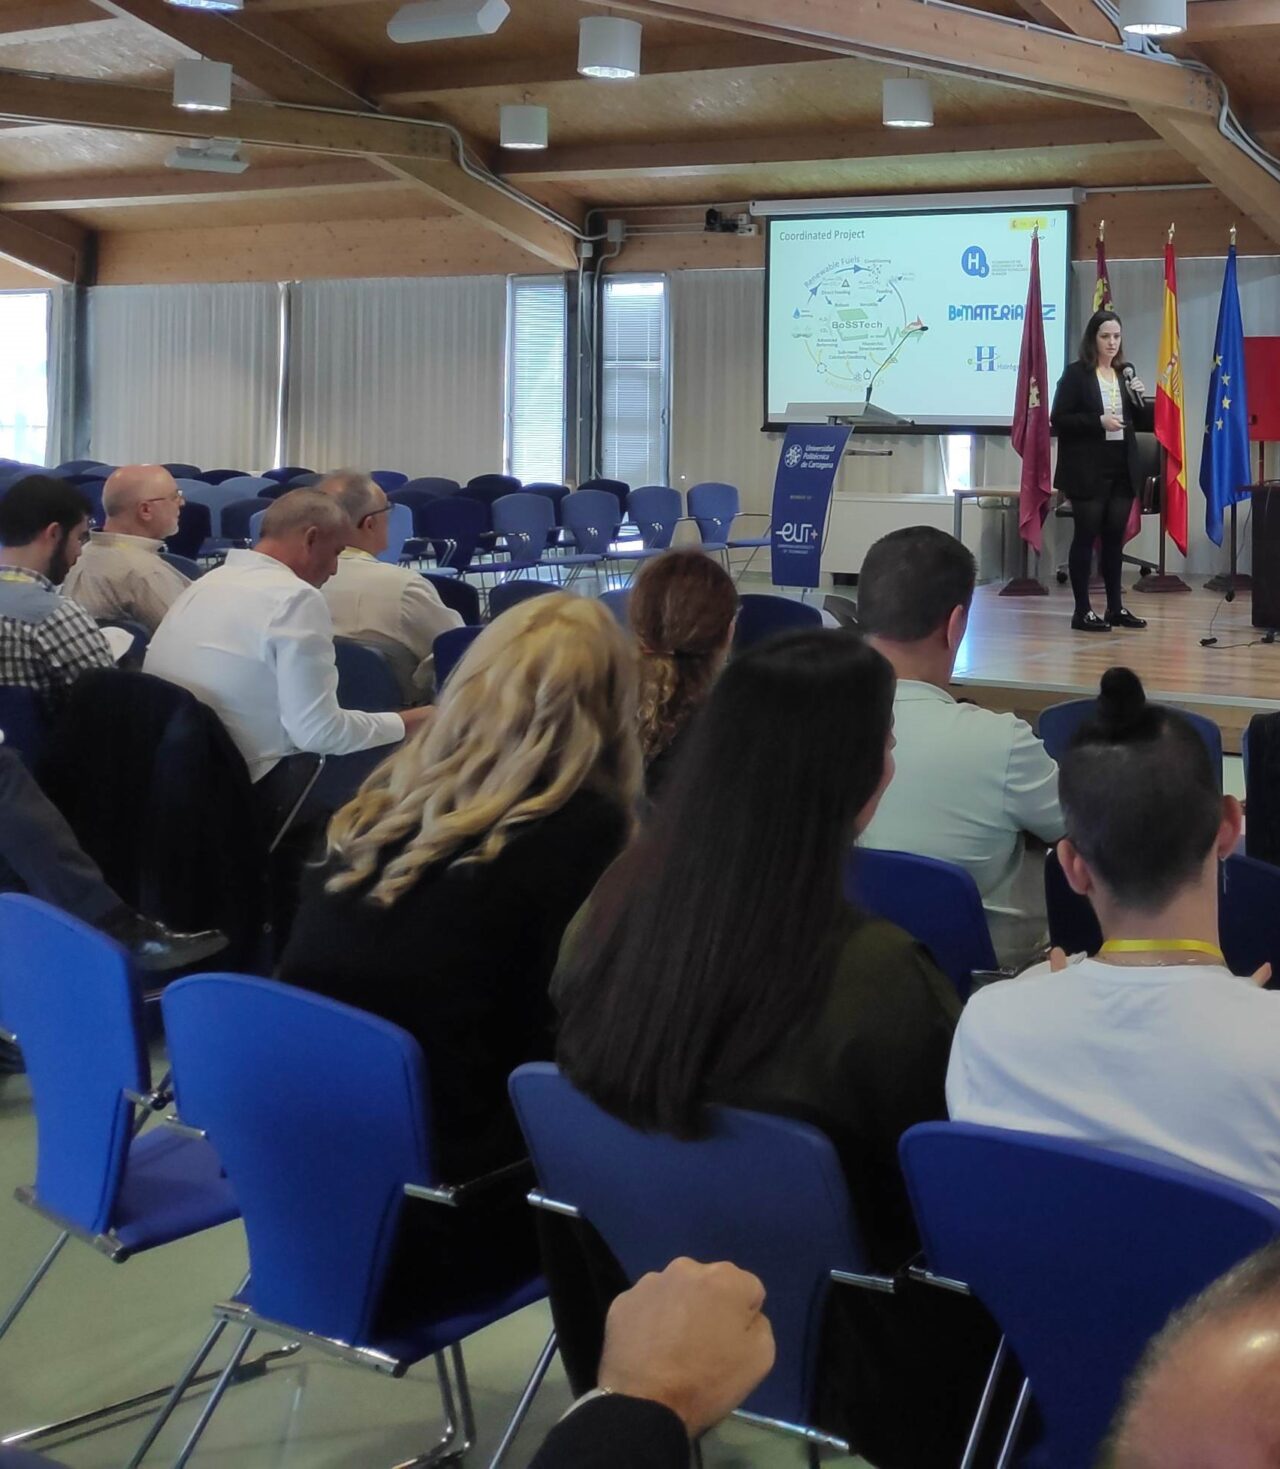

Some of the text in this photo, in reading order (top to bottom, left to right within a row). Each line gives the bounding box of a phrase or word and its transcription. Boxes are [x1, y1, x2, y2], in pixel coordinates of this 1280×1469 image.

[780, 229, 865, 241] Coordinated Project
[804, 262, 840, 288] Renewable
[832, 321, 882, 329] BoSSTech
[805, 444, 836, 452] Universidad
[802, 452, 830, 460] Politécnica
[808, 461, 834, 470] Cartagena
